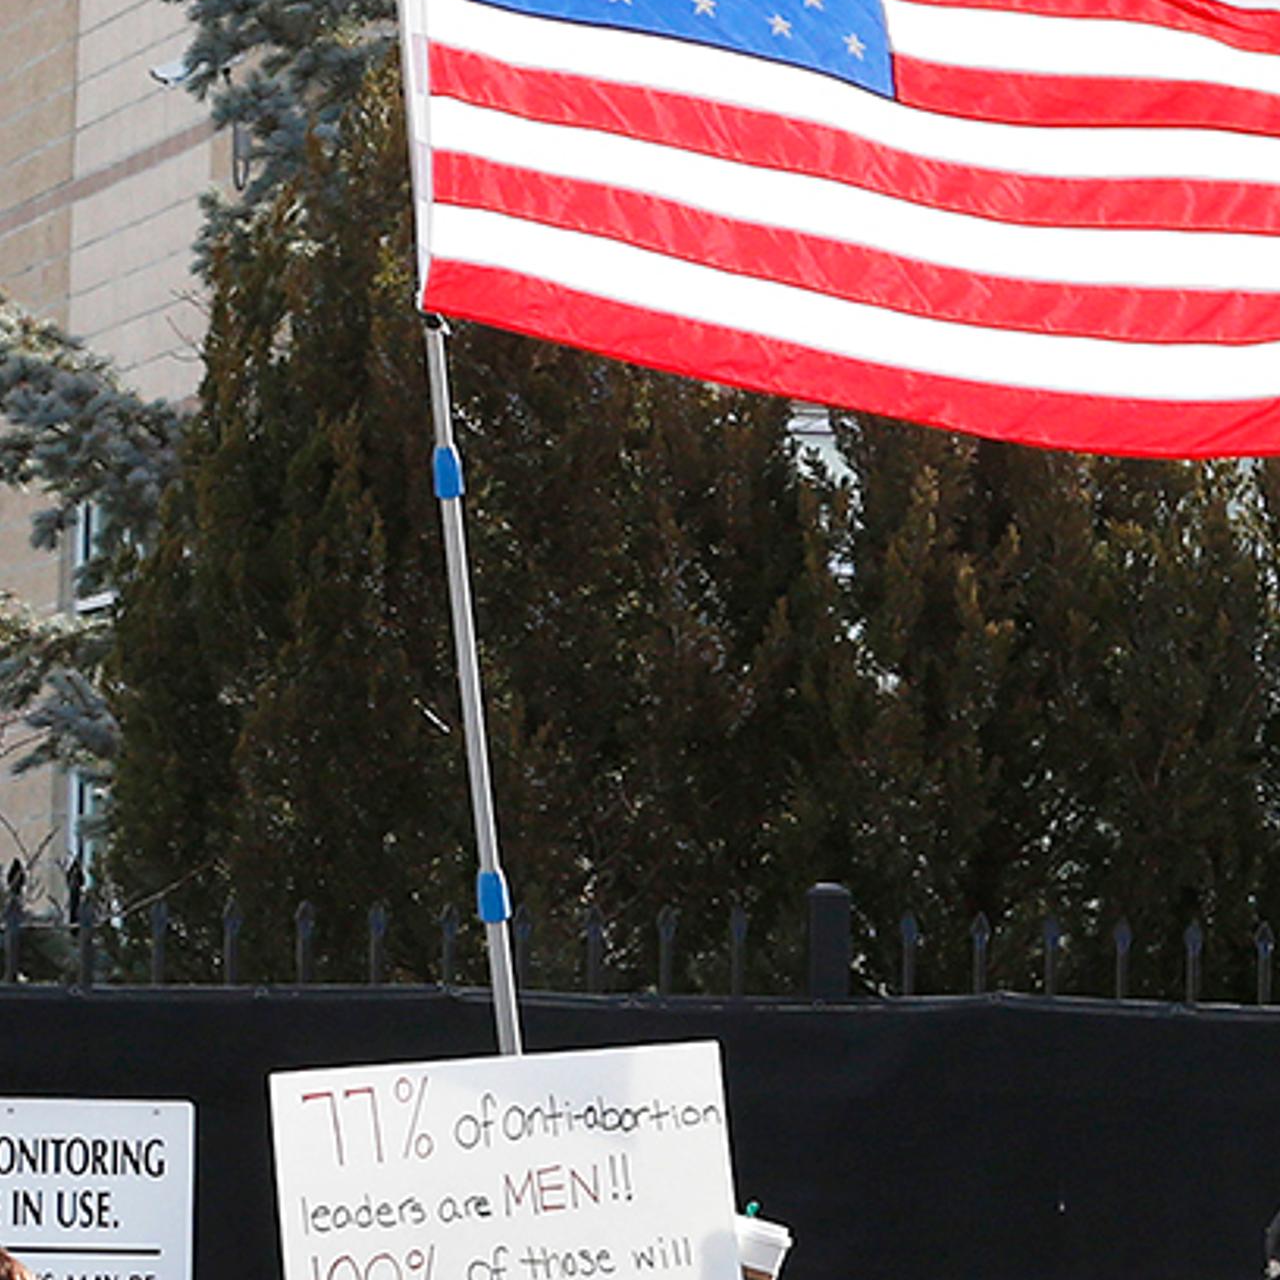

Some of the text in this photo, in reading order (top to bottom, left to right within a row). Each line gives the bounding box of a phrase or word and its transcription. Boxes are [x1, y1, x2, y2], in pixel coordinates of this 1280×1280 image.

[302, 1075, 433, 1166] 77%
[455, 1093, 497, 1150] of
[0, 1136, 165, 1178] ONITORING
[12, 1190, 120, 1229] IN USE.
[301, 1153, 634, 1236] leaders are MEN!!
[520, 1247, 617, 1280] those
[632, 1236, 693, 1270] will
